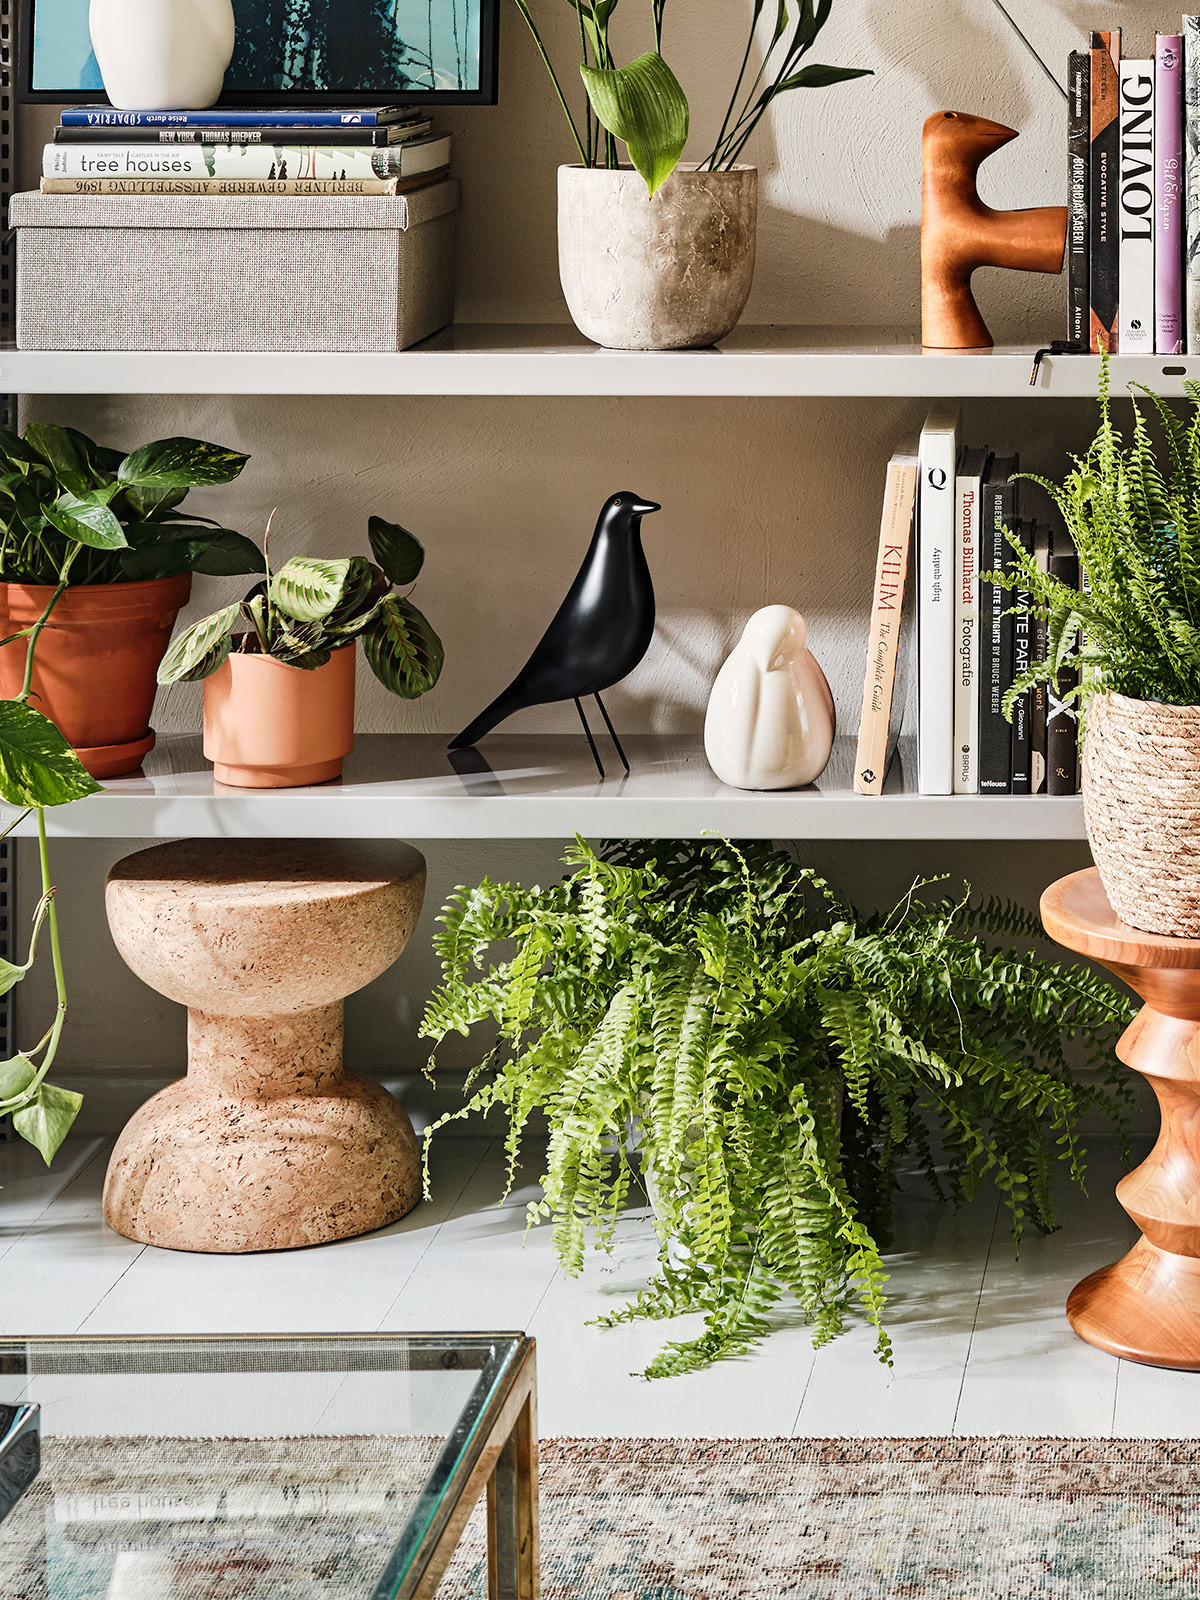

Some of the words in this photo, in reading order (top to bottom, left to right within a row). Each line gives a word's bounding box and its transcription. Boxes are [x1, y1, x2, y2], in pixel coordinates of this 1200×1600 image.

[87, 113, 141, 126] SÜDAFRIKA
[146, 115, 167, 123] durch
[168, 115, 188, 123] Reise
[159, 132, 176, 142] NEW
[176, 132, 196, 142] YORK
[200, 132, 230, 142] THOMAS
[231, 132, 262, 142] HOEPKER
[80, 154, 119, 172] tree
[126, 151, 192, 172] houses
[1121, 74, 1153, 243] LOVING
[1163, 158, 1178, 180] Gil
[1072, 158, 1085, 183] BORIS
[108, 181, 210, 192] AUSSTELLUNG
[219, 182, 286, 192] GEWERBE
[294, 182, 364, 193] BERLINER
[1072, 184, 1085, 214] BIDJAN
[1159, 181, 1178, 232] Elvgren
[1072, 216, 1085, 244] SABERI
[928, 468, 947, 490] Q
[962, 490, 974, 544] Thomas
[994, 532, 1002, 556] BOLLE
[933, 548, 942, 580] quality
[962, 546, 974, 604] Billhardt
[993, 558, 1002, 569] AN
[878, 544, 903, 611] KILIM
[932, 582, 942, 602] high
[1017, 568, 1030, 633] PIVATE
[992, 606, 1001, 614] IN
[878, 622, 891, 639] The
[992, 616, 1000, 644] TIGHTS
[1036, 628, 1045, 640] ed
[872, 641, 888, 682] Complete
[960, 618, 973, 687] Fotografie
[992, 646, 1000, 657] BY
[992, 658, 1000, 684] BRUCE
[871, 684, 883, 713] Guide
[991, 686, 999, 714] WEBER
[1017, 698, 1025, 708] by
